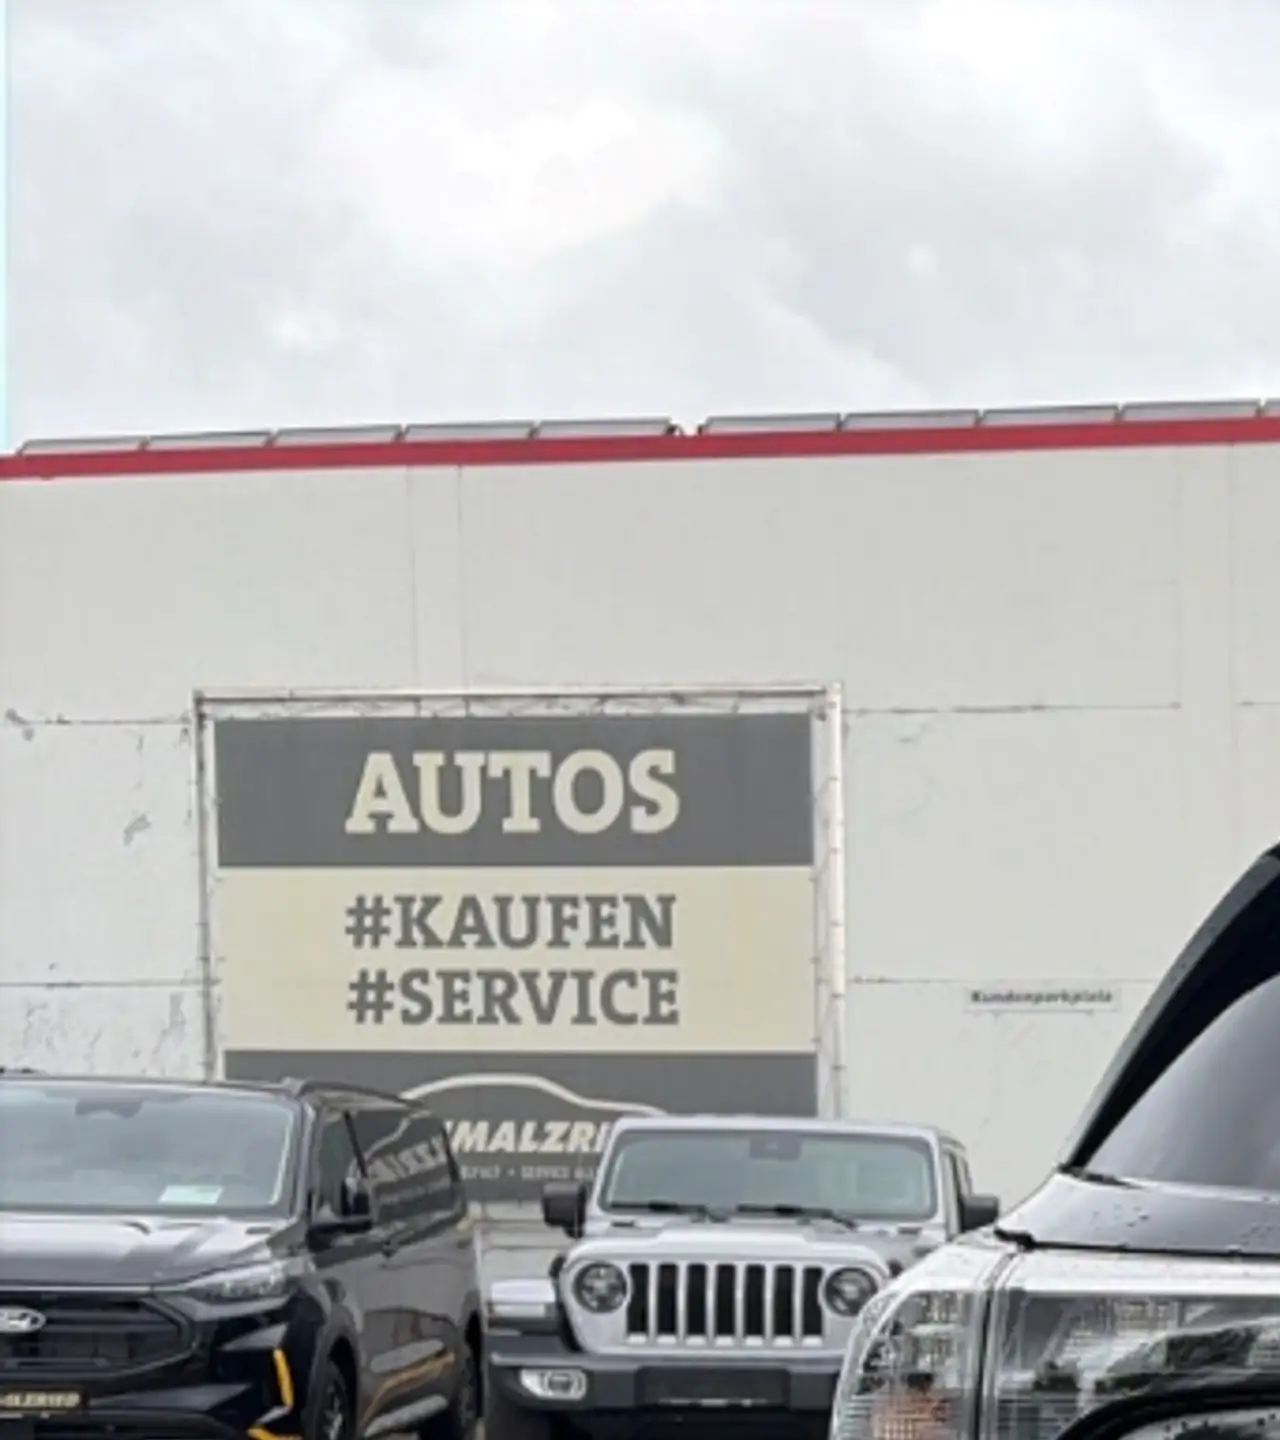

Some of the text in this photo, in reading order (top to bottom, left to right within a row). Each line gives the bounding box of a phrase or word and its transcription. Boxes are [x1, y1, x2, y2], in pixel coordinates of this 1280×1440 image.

[344, 749, 681, 834] AUTOS
[344, 894, 677, 949] #KAUFEN
[347, 968, 681, 1025] #SERVICE
